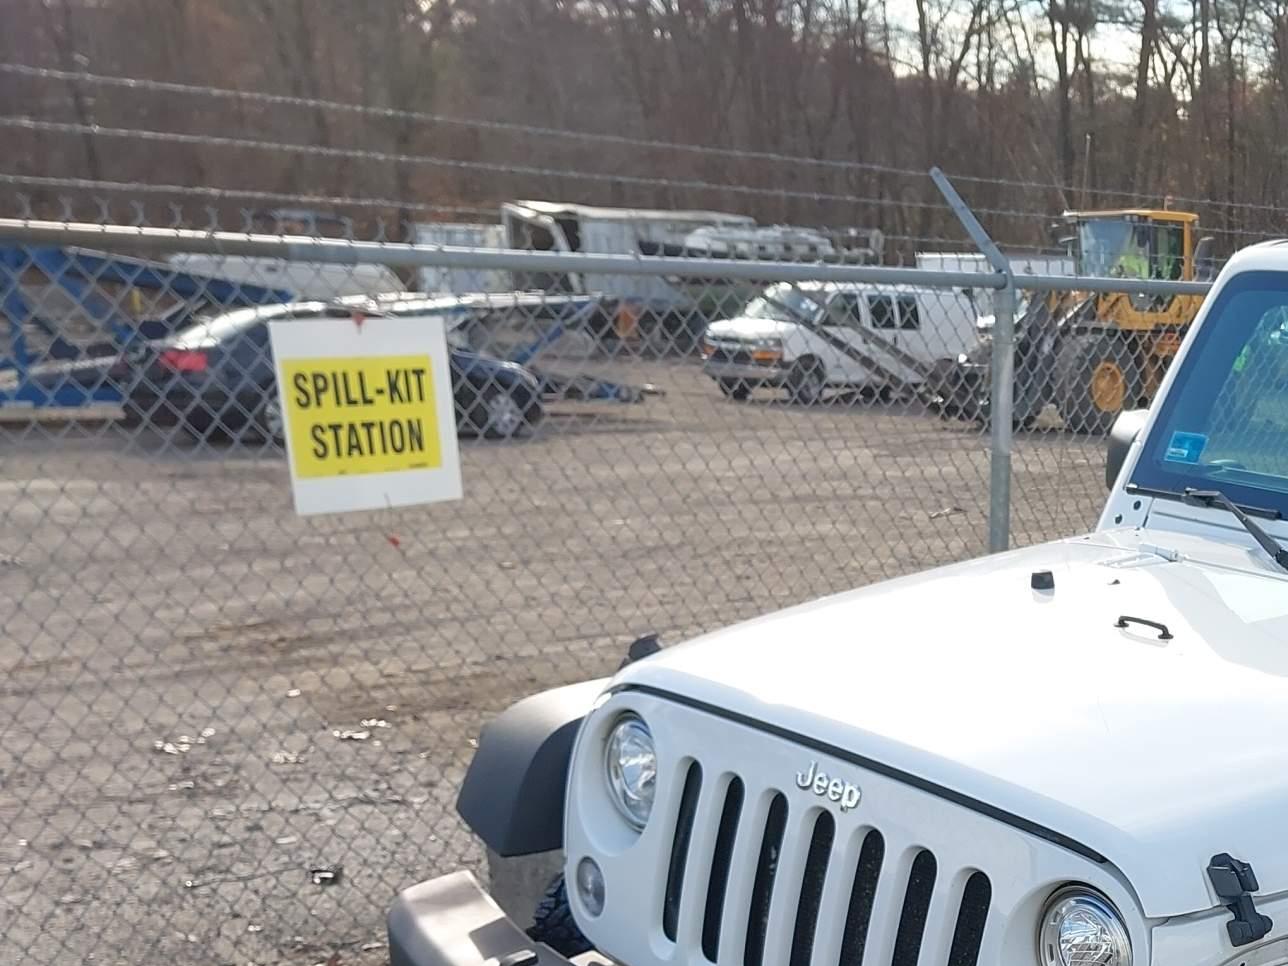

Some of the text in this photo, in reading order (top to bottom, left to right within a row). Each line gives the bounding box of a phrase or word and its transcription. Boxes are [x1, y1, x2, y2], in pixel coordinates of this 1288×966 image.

[293, 368, 426, 409] SPILL-KIT
[311, 419, 425, 459] STATION
[796, 760, 862, 813] Jeep
